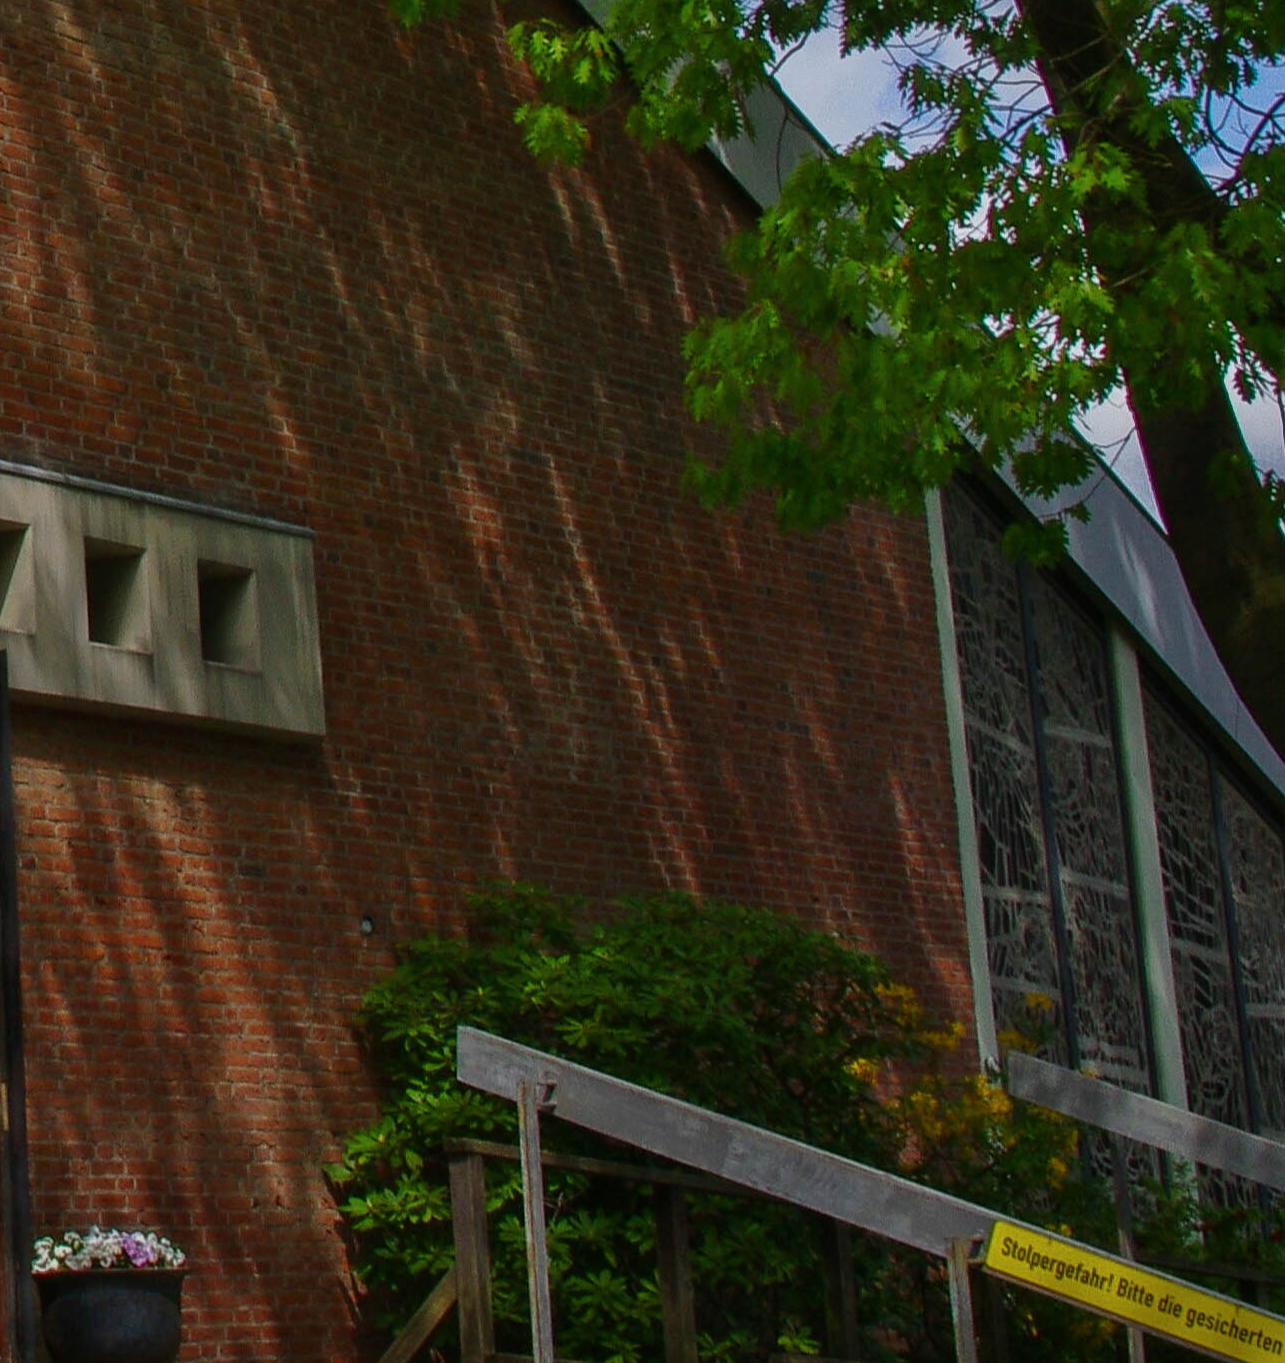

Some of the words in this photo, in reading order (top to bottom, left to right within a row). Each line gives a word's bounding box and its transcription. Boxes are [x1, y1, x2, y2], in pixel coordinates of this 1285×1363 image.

[1001, 1237, 1115, 1293] Stolpergefahr!
[1116, 1277, 1154, 1308] Bitte
[1158, 1296, 1183, 1317] die
[1186, 1308, 1282, 1355] gesicherten
